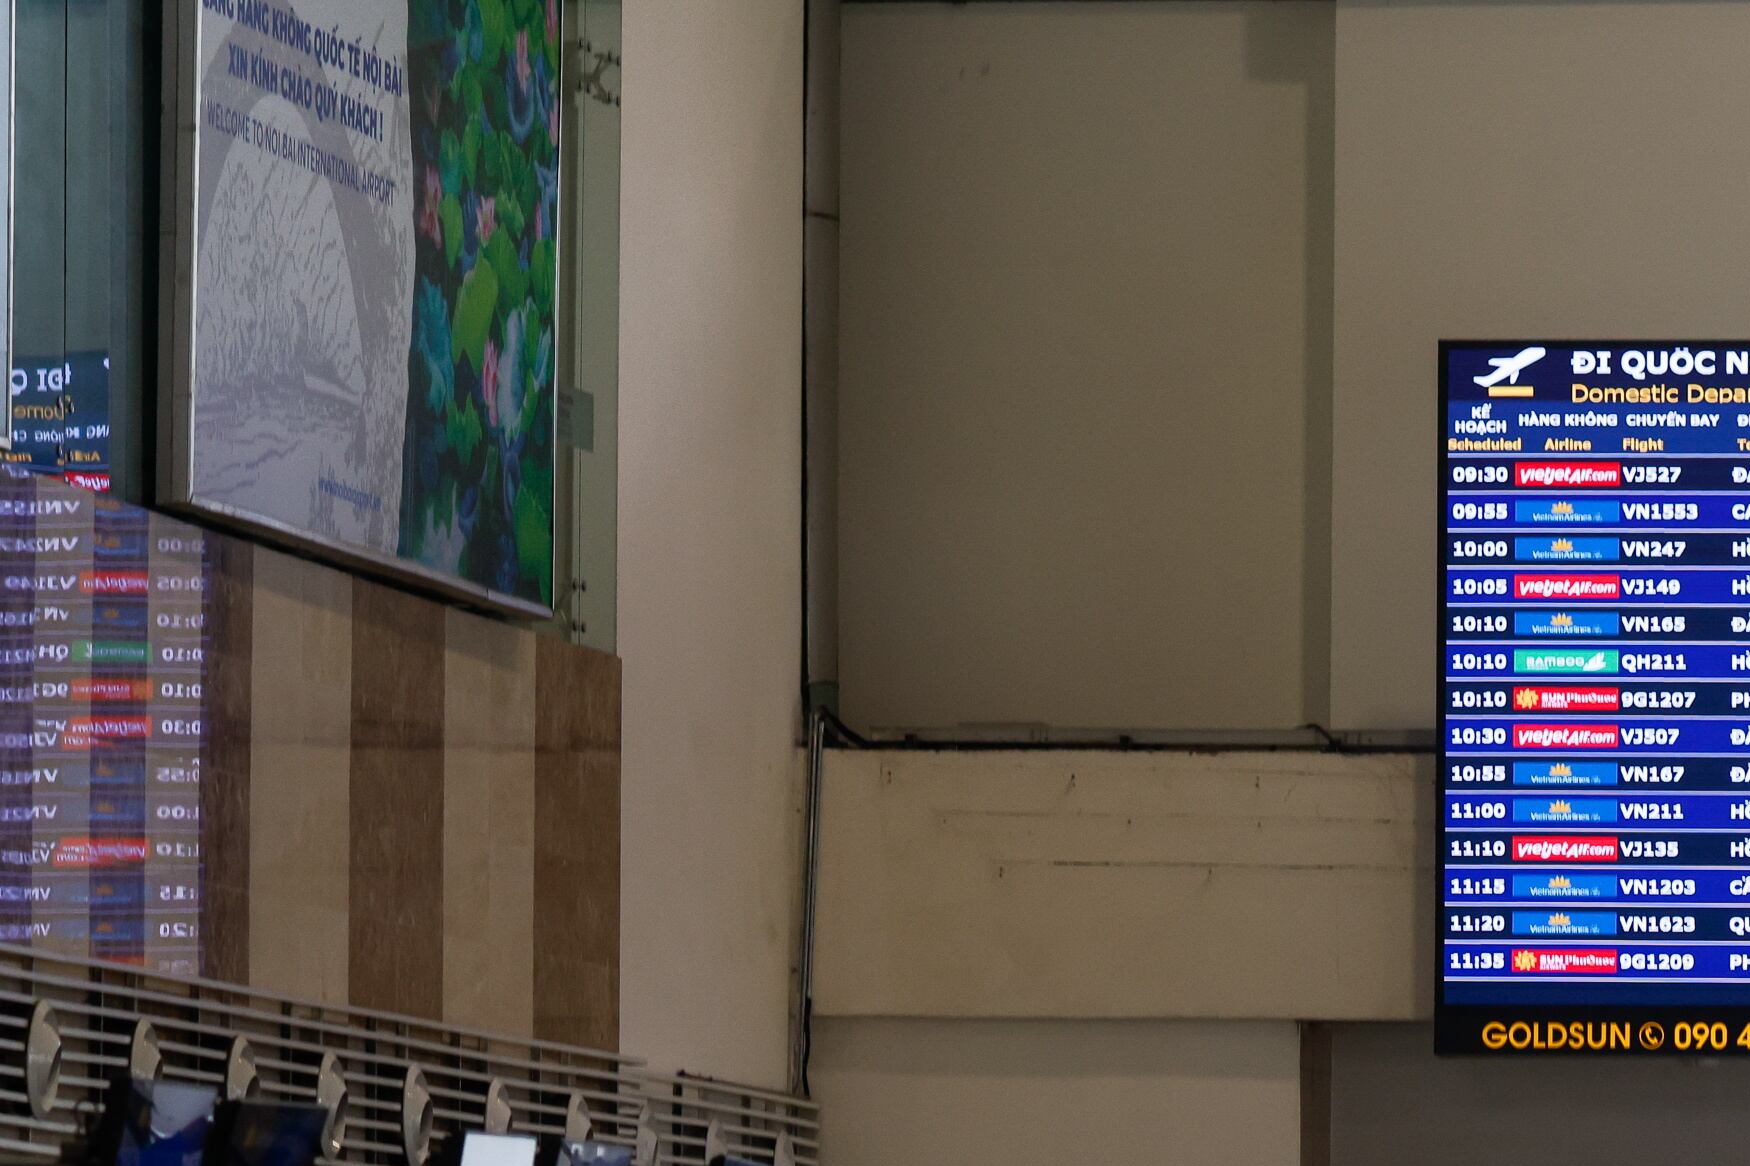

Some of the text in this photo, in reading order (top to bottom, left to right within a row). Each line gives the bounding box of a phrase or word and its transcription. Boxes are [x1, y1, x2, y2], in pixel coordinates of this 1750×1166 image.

[314, 25, 345, 70] QUỐC
[229, 42, 248, 81] XIN
[251, 48, 278, 95] KÍNH
[314, 82, 338, 123] QUÝ
[340, 93, 377, 141] KHÁCH
[207, 102, 250, 144] WELCOME
[253, 119, 264, 148] TO
[297, 139, 360, 192] INTERNATIONAL
[361, 169, 396, 207] AIRPORT
[1571, 350, 1612, 375] ĐI
[1571, 383, 1679, 403] Domestic
[1518, 411, 1618, 428] HÀNG KHÔNG
[1691, 414, 1720, 428] BAY
[1448, 437, 1522, 452] Scheduled
[1544, 437, 1592, 452] Airline
[1622, 437, 1664, 454] Flight
[1452, 502, 1508, 520] 09:55
[1621, 502, 1699, 521] VN1553
[1453, 578, 1508, 595] 10:05
[1621, 578, 1681, 596] VJ149
[1452, 653, 1507, 670] 10:10
[1621, 653, 1687, 674] QH211
[1452, 690, 1507, 708] 10:10
[1621, 691, 1696, 709] 9G1207
[1451, 840, 1506, 857] 11:10
[1619, 840, 1679, 858] VJ135
[1482, 1021, 1631, 1049] GOLDSUN
[1674, 1022, 1728, 1050] 090
